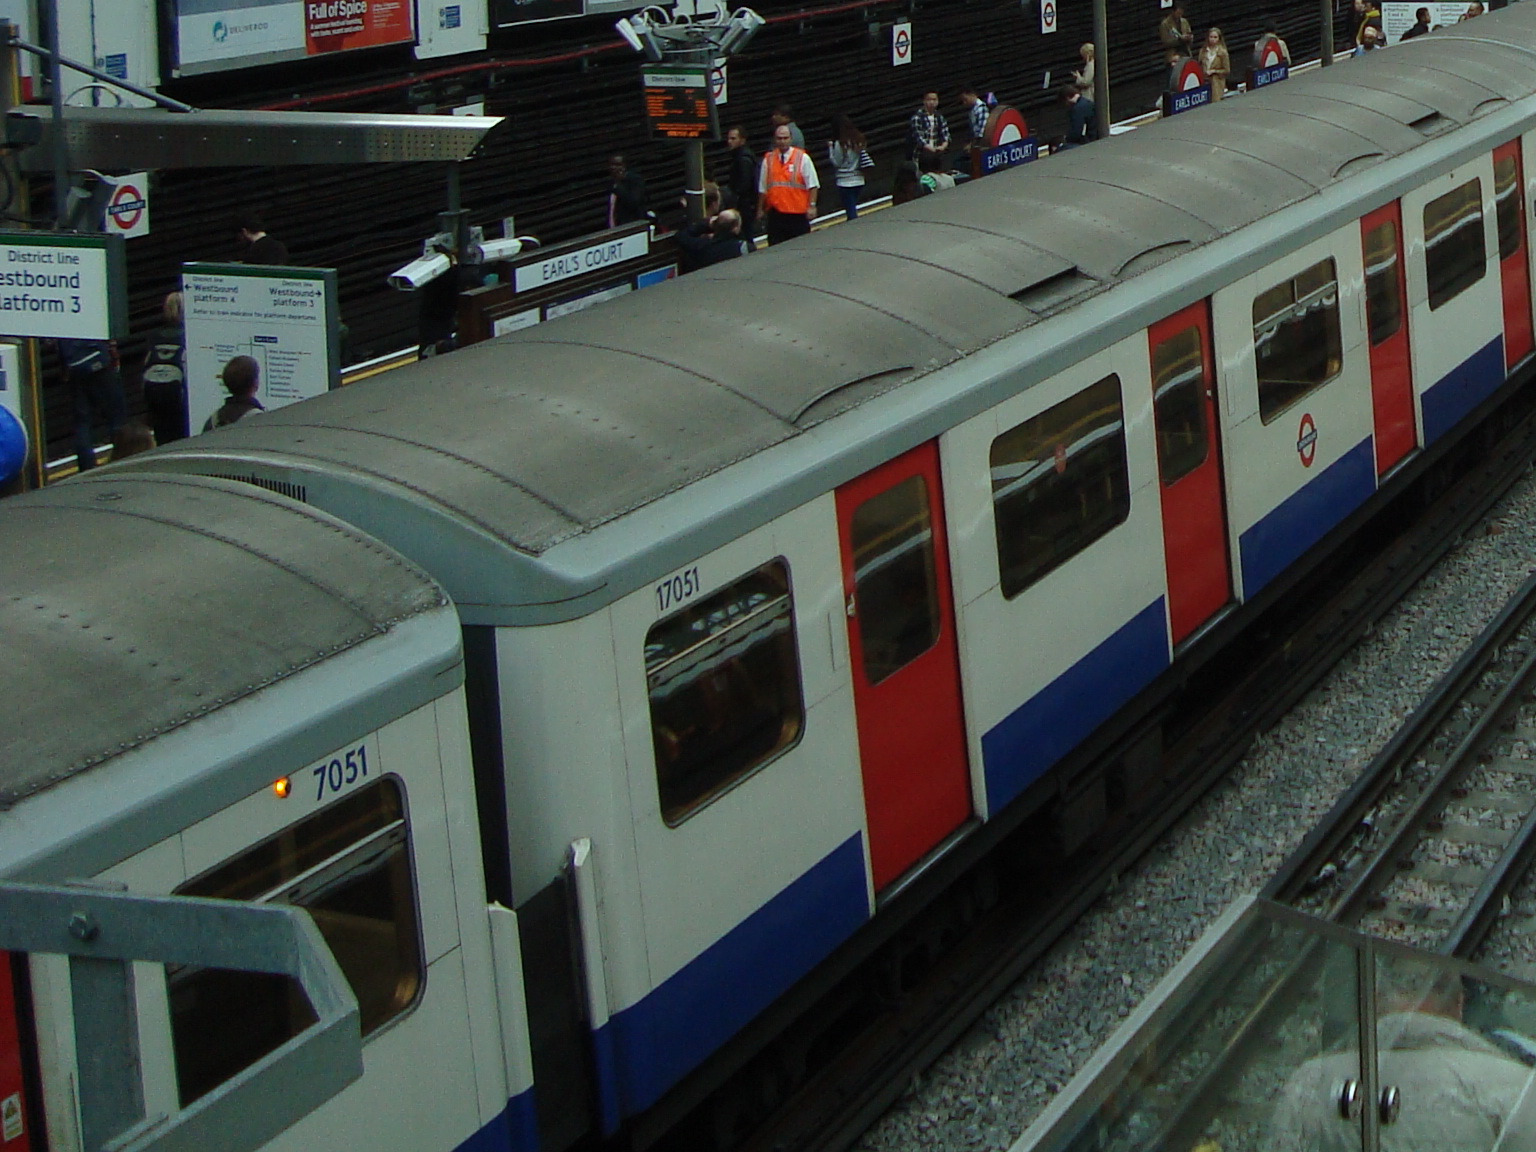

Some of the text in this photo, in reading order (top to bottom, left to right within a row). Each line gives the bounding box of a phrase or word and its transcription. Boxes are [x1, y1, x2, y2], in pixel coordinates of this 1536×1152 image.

[309, 3, 327, 19] Full
[328, 1, 338, 17] of
[339, 0, 367, 18] Spice
[1271, 67, 1285, 81] COURT
[1175, 91, 1208, 111] EARL'S COURT
[987, 144, 1033, 169] EARL'S COURT
[8, 250, 79, 264] District line
[542, 243, 623, 280] EARL'S COURT
[194, 284, 238, 293] Westbound
[269, 288, 314, 297] Westbound
[71, 296, 80, 313] 3
[194, 294, 228, 302] platform
[273, 299, 307, 307] platform
[657, 566, 699, 610] 17051
[313, 745, 367, 801] 7051
